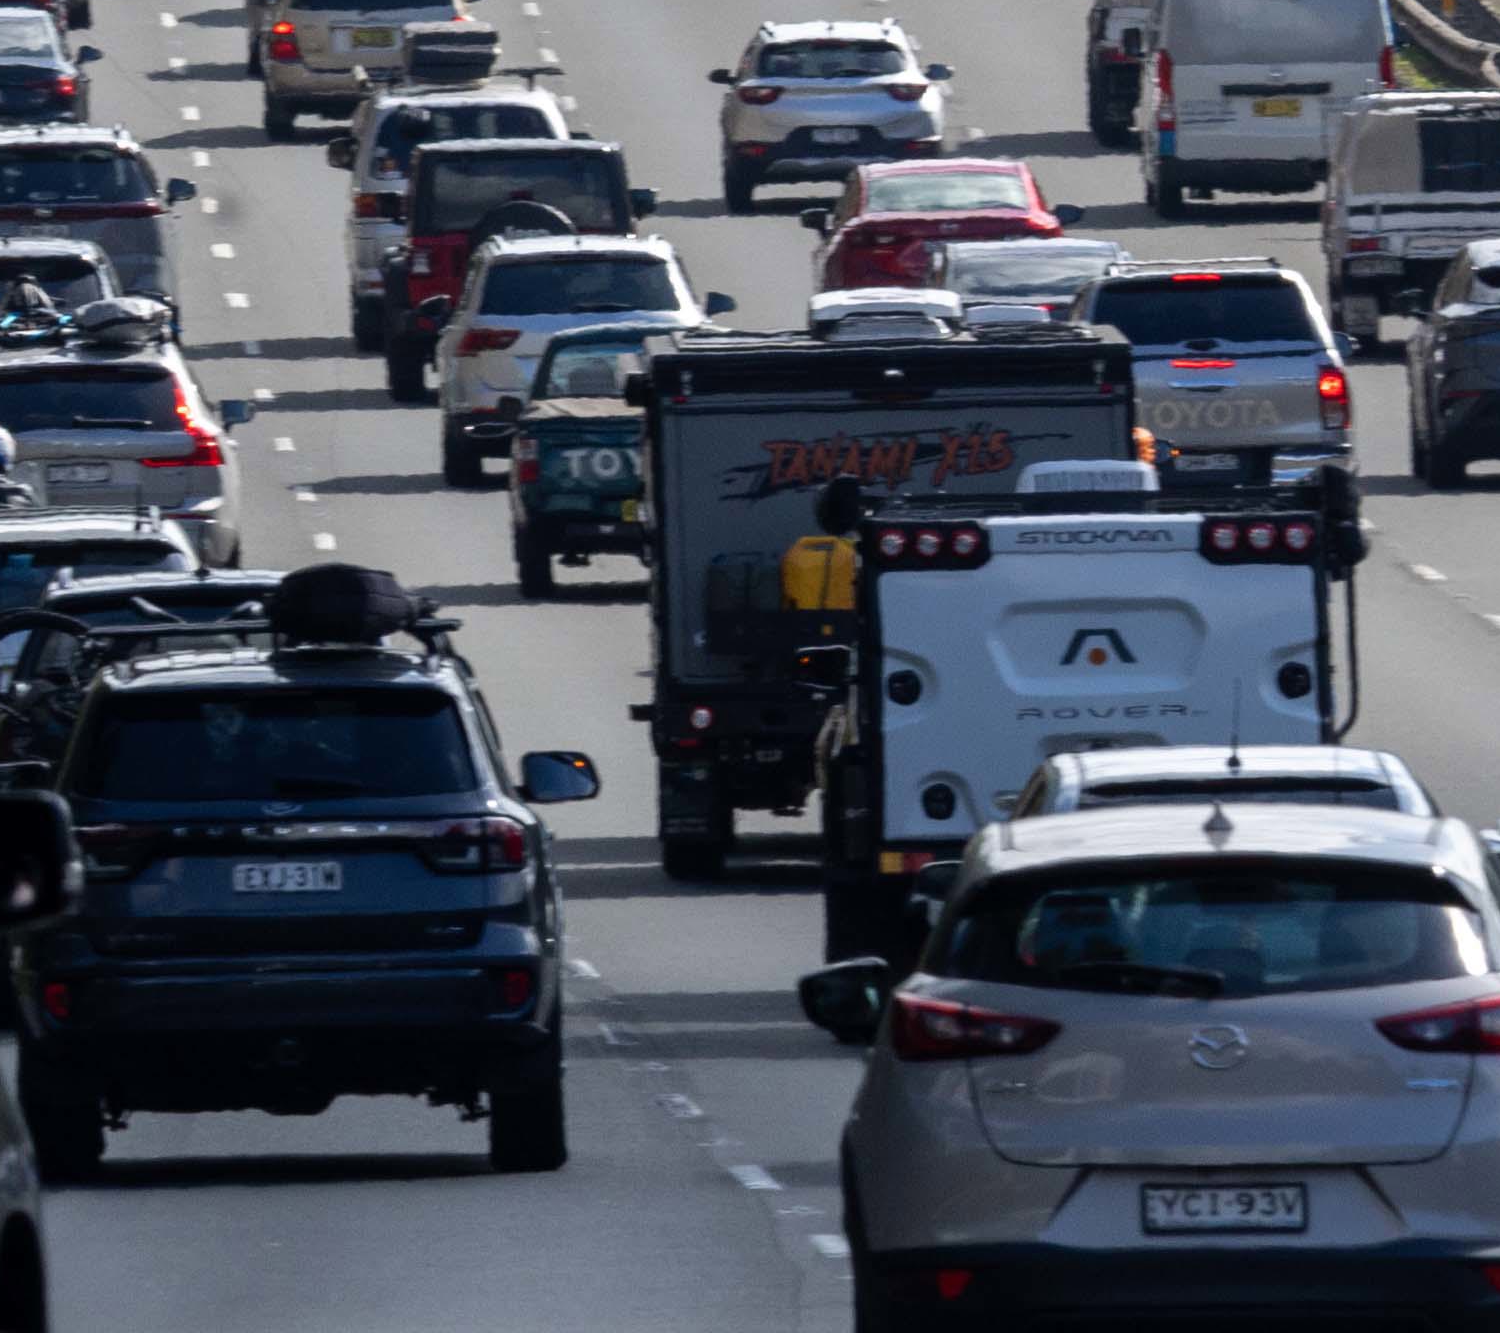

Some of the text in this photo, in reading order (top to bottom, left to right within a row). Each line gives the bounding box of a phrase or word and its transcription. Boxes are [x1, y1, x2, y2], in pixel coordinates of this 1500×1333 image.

[1133, 398, 1282, 429] TOYOTA
[760, 431, 919, 491] TANAMI
[1015, 529, 1174, 545] STOCKMAN
[1015, 704, 1188, 721] ROVER
